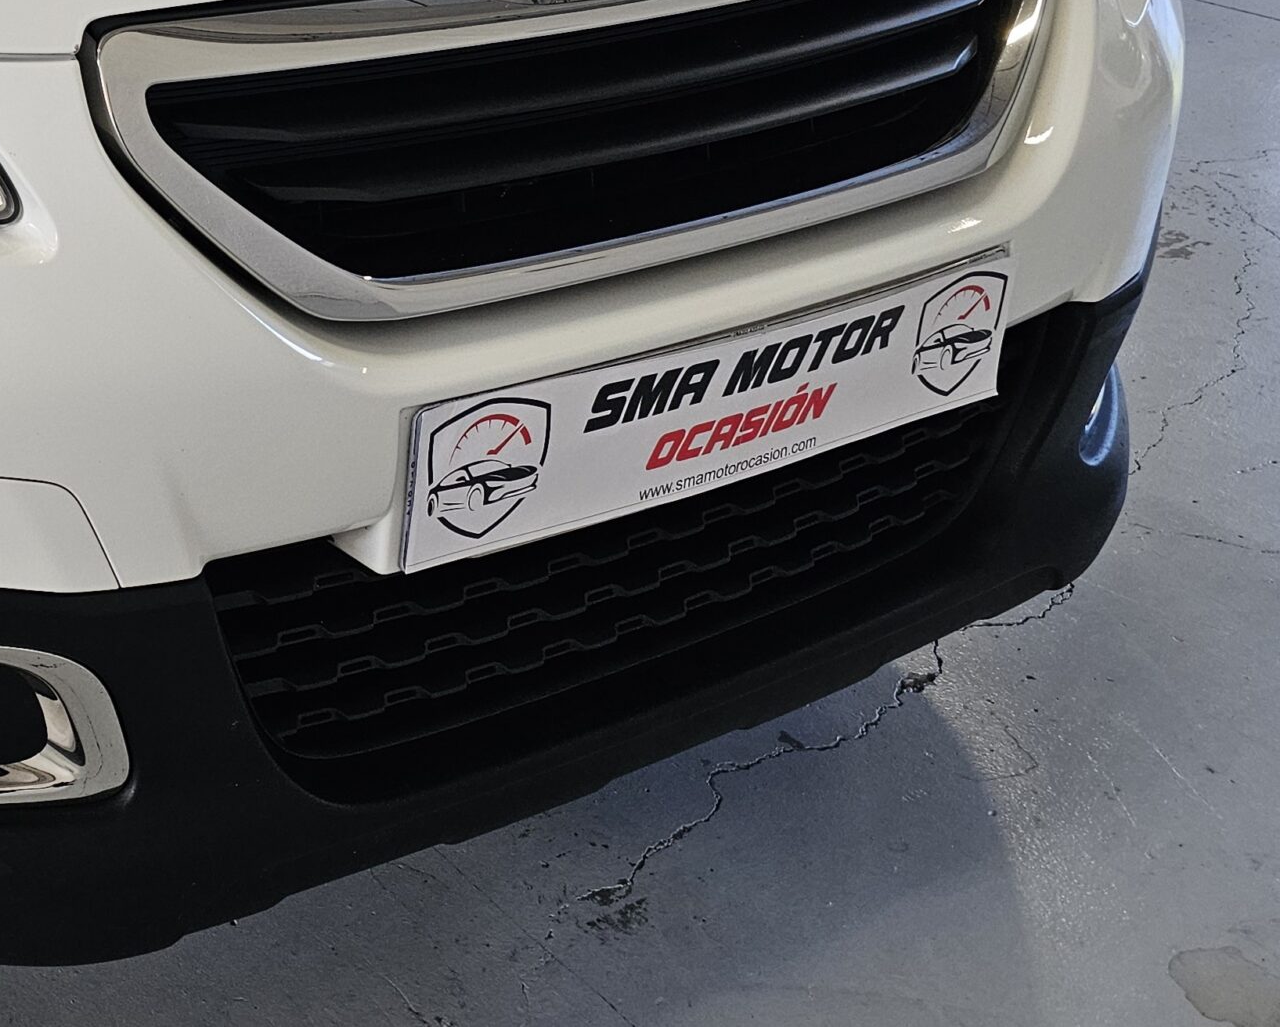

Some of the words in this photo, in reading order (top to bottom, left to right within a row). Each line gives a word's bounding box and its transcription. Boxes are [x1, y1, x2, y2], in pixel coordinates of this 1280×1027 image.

[583, 359, 720, 433] SMA
[721, 305, 906, 397] MOTOR
[639, 436, 817, 501] www.smamotorocasion.com
[646, 382, 838, 470] OCASIÓN
